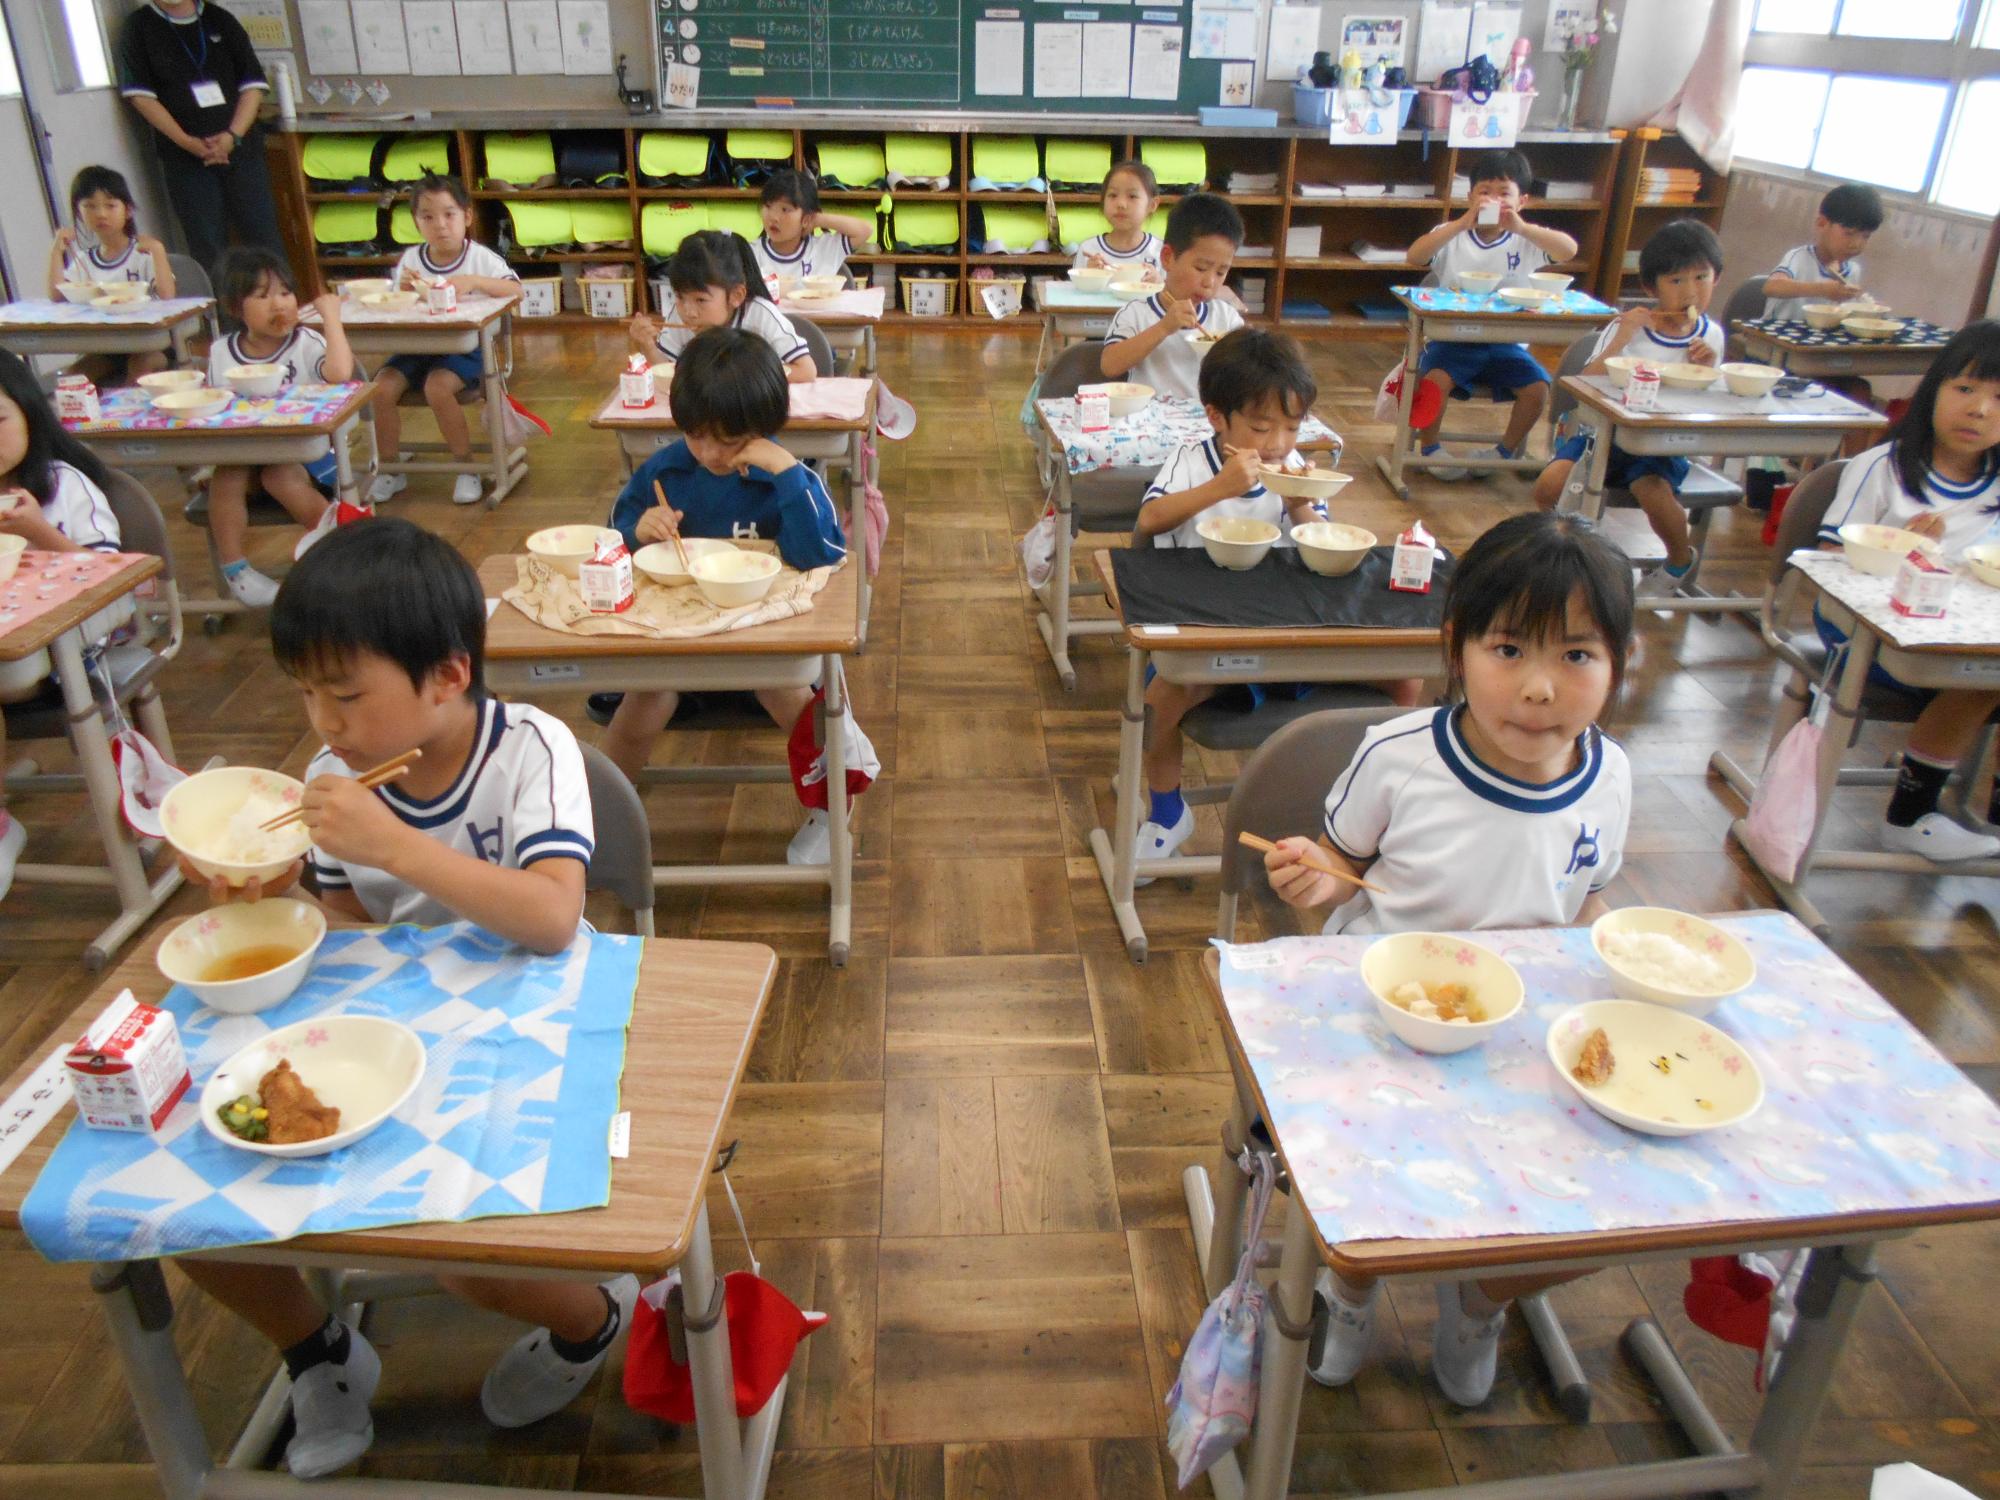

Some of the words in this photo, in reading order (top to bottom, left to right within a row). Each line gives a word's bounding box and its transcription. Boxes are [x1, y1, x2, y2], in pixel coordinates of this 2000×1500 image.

[663, 20, 675, 36] 4
[664, 47, 676, 63] 5
[670, 83, 695, 97] ひだり
[1226, 81, 1248, 97] みぎ
[1216, 656, 1225, 667] L
[534, 666, 543, 676] L
